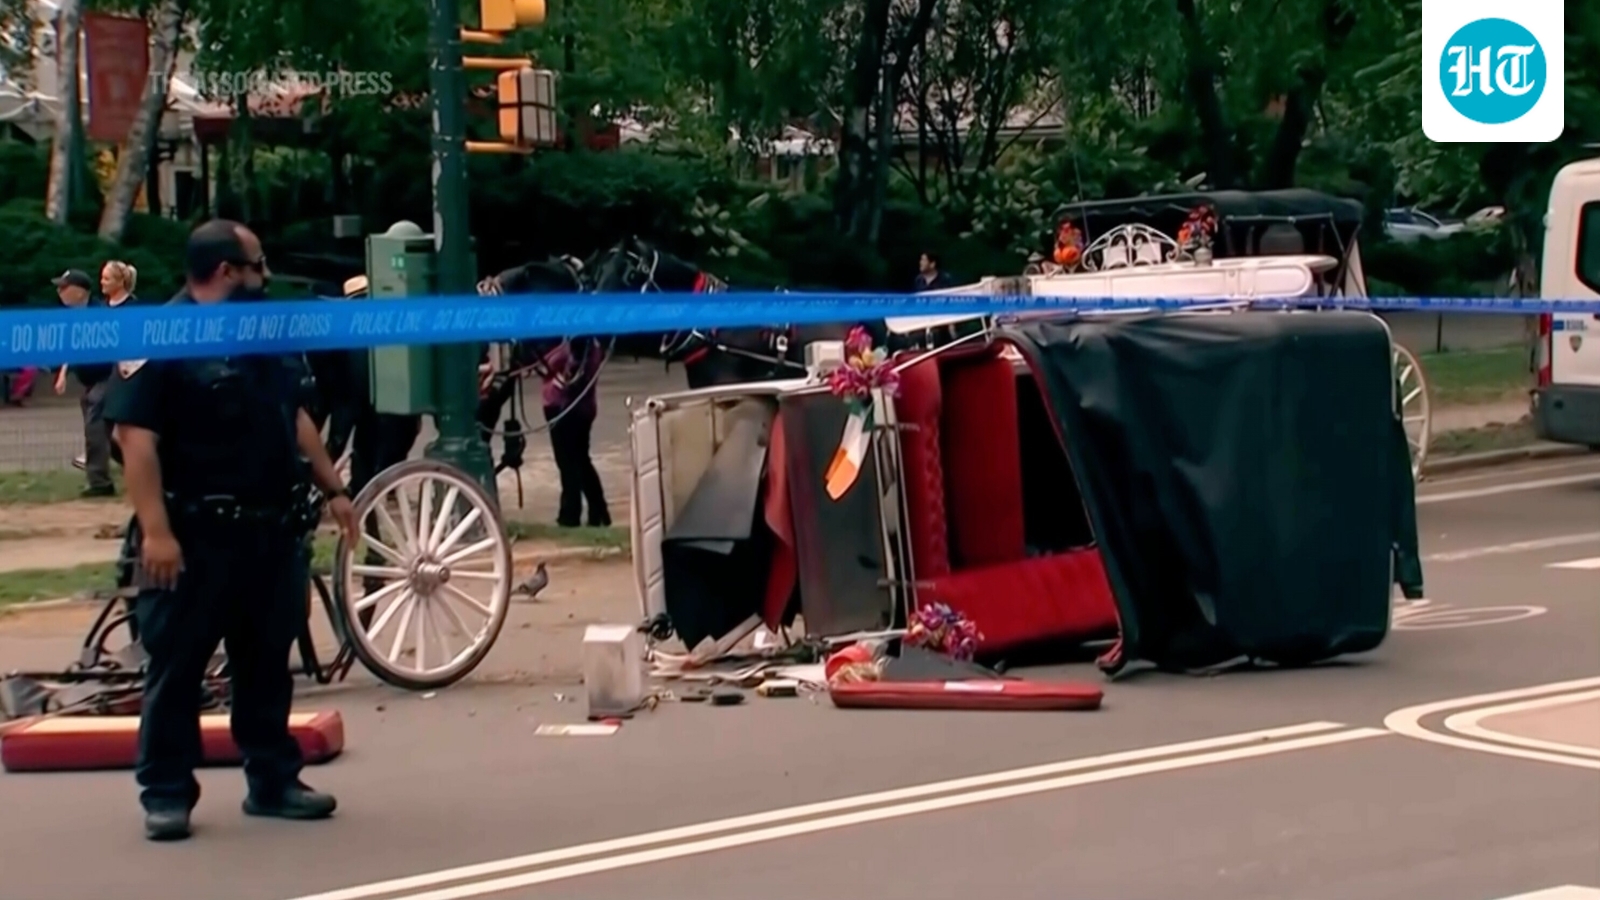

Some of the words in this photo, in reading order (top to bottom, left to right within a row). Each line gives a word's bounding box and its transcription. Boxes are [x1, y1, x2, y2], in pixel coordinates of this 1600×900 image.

[11, 323, 32, 352] DO
[36, 322, 67, 351] NOT
[71, 319, 120, 350] CROSS
[142, 317, 191, 347] POLICE
[195, 316, 227, 344] LINE
[236, 315, 257, 342] DO
[258, 314, 285, 340] NOT
[288, 313, 333, 339] CROSS
[349, 309, 395, 335] POLICE
